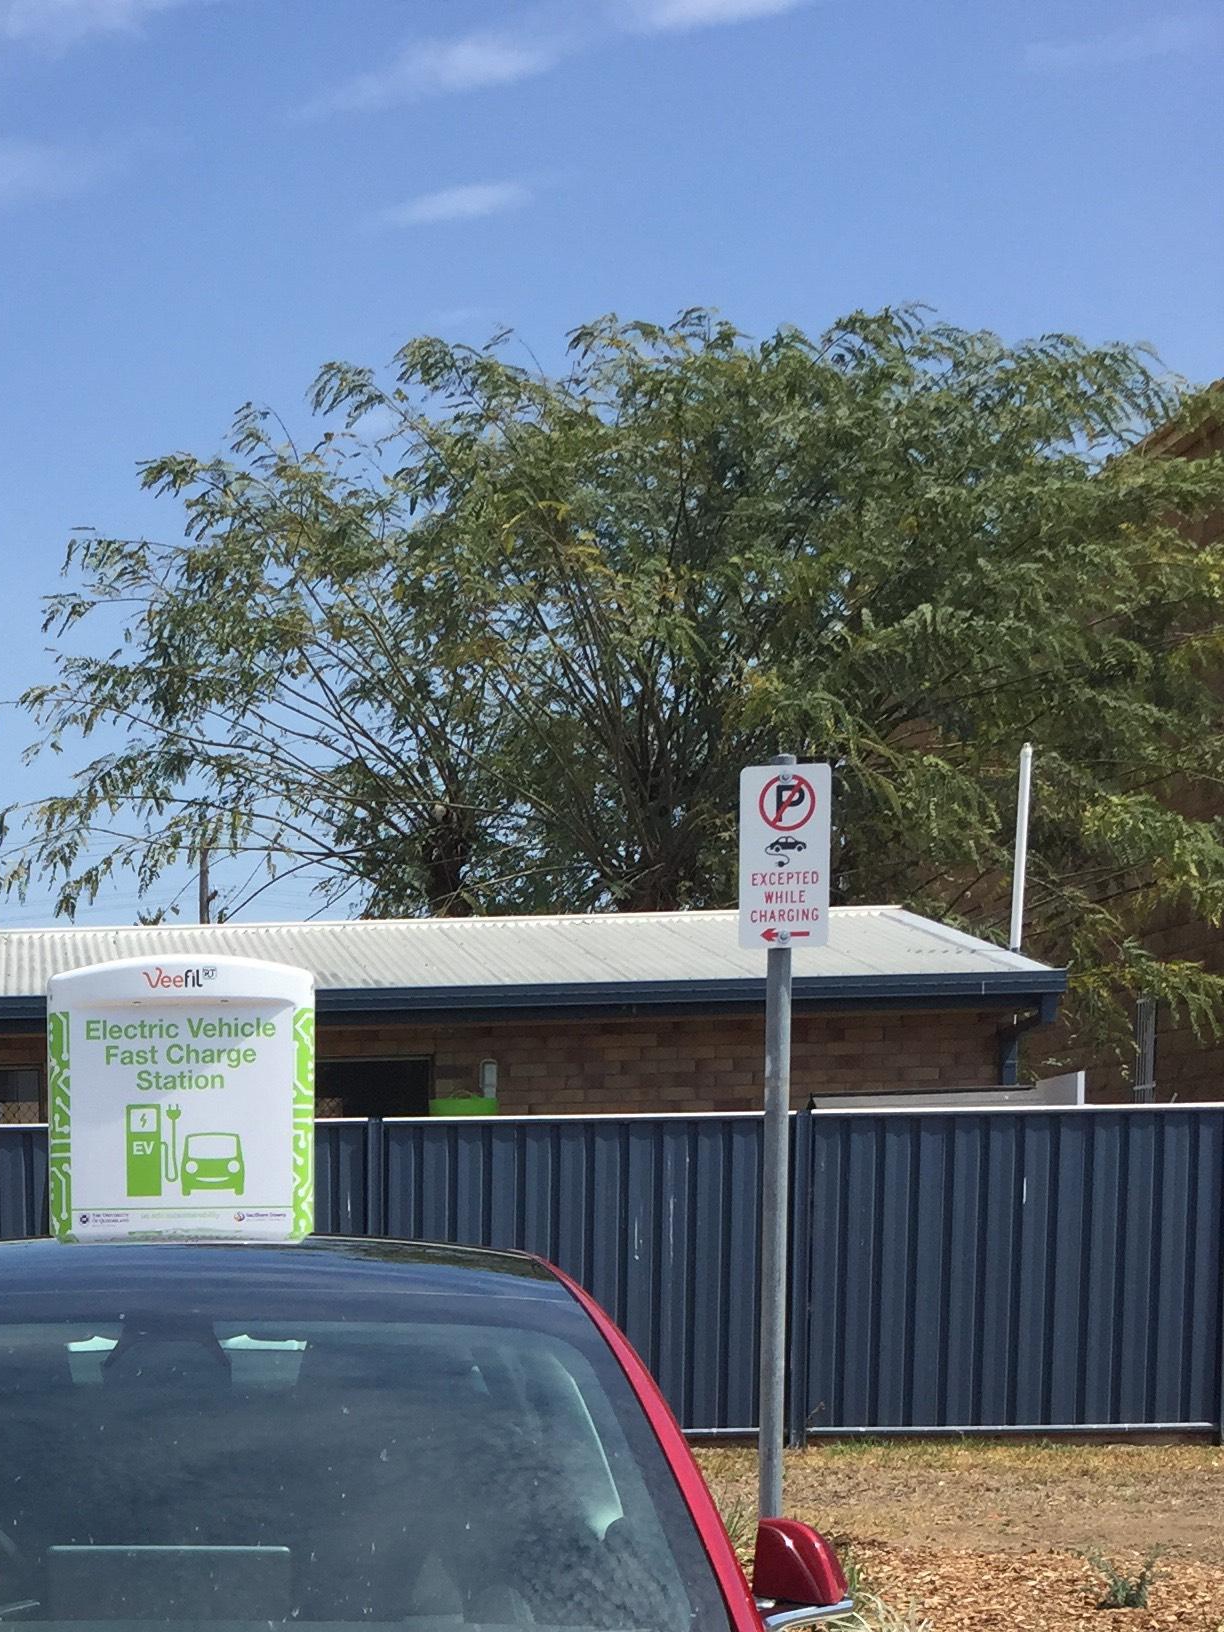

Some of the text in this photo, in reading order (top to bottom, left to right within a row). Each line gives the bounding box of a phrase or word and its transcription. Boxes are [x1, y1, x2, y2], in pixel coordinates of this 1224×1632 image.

[751, 871, 819, 886] EXCEPTED
[764, 890, 806, 904] WHILE
[750, 908, 819, 923] CHARGING
[142, 967, 203, 989] Veefil
[85, 1017, 277, 1041] Electric Vehicle
[105, 1043, 257, 1069] Fast Charge
[136, 1070, 225, 1091] Station
[132, 1141, 154, 1156] EV
